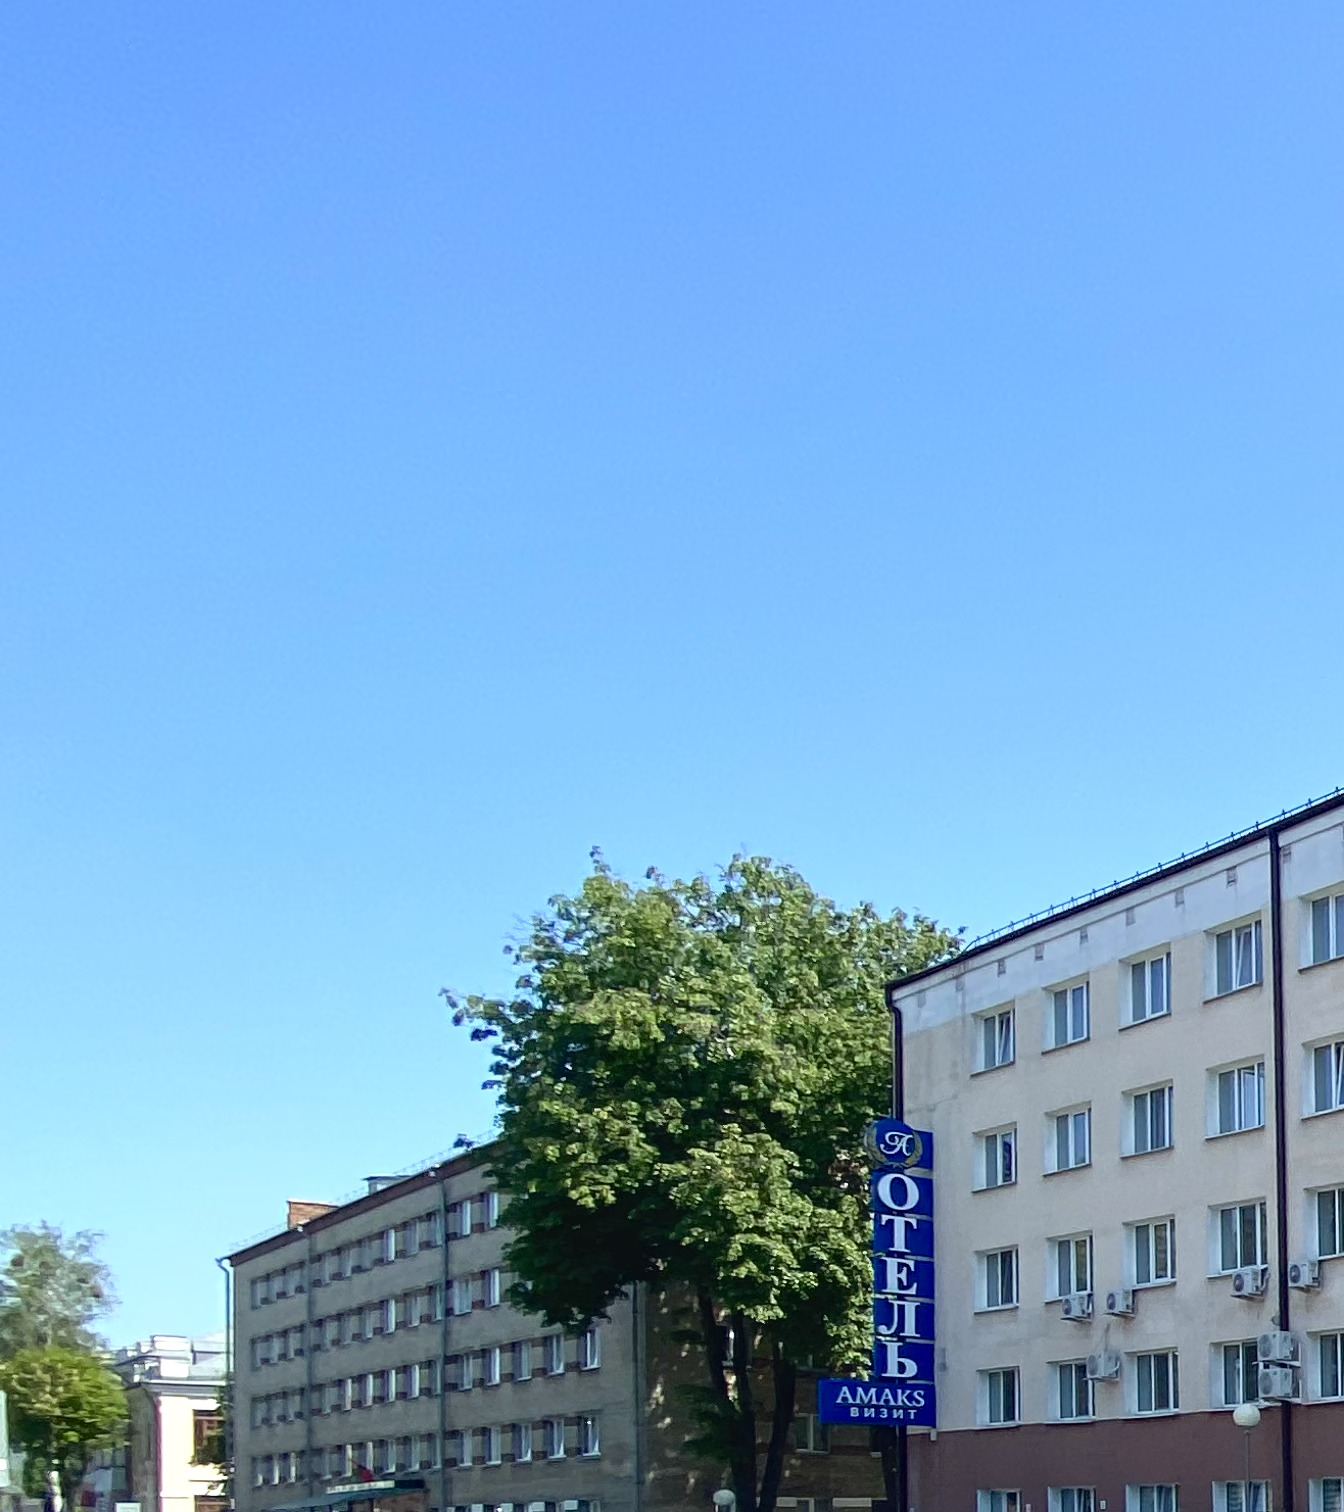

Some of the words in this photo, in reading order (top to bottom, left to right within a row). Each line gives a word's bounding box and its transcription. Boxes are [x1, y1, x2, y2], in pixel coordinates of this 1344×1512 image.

[877, 1173, 920, 1378] ОТЕЛЬ
[835, 1386, 925, 1407] AMAKS
[850, 1406, 917, 1419] ВИЗИТ
